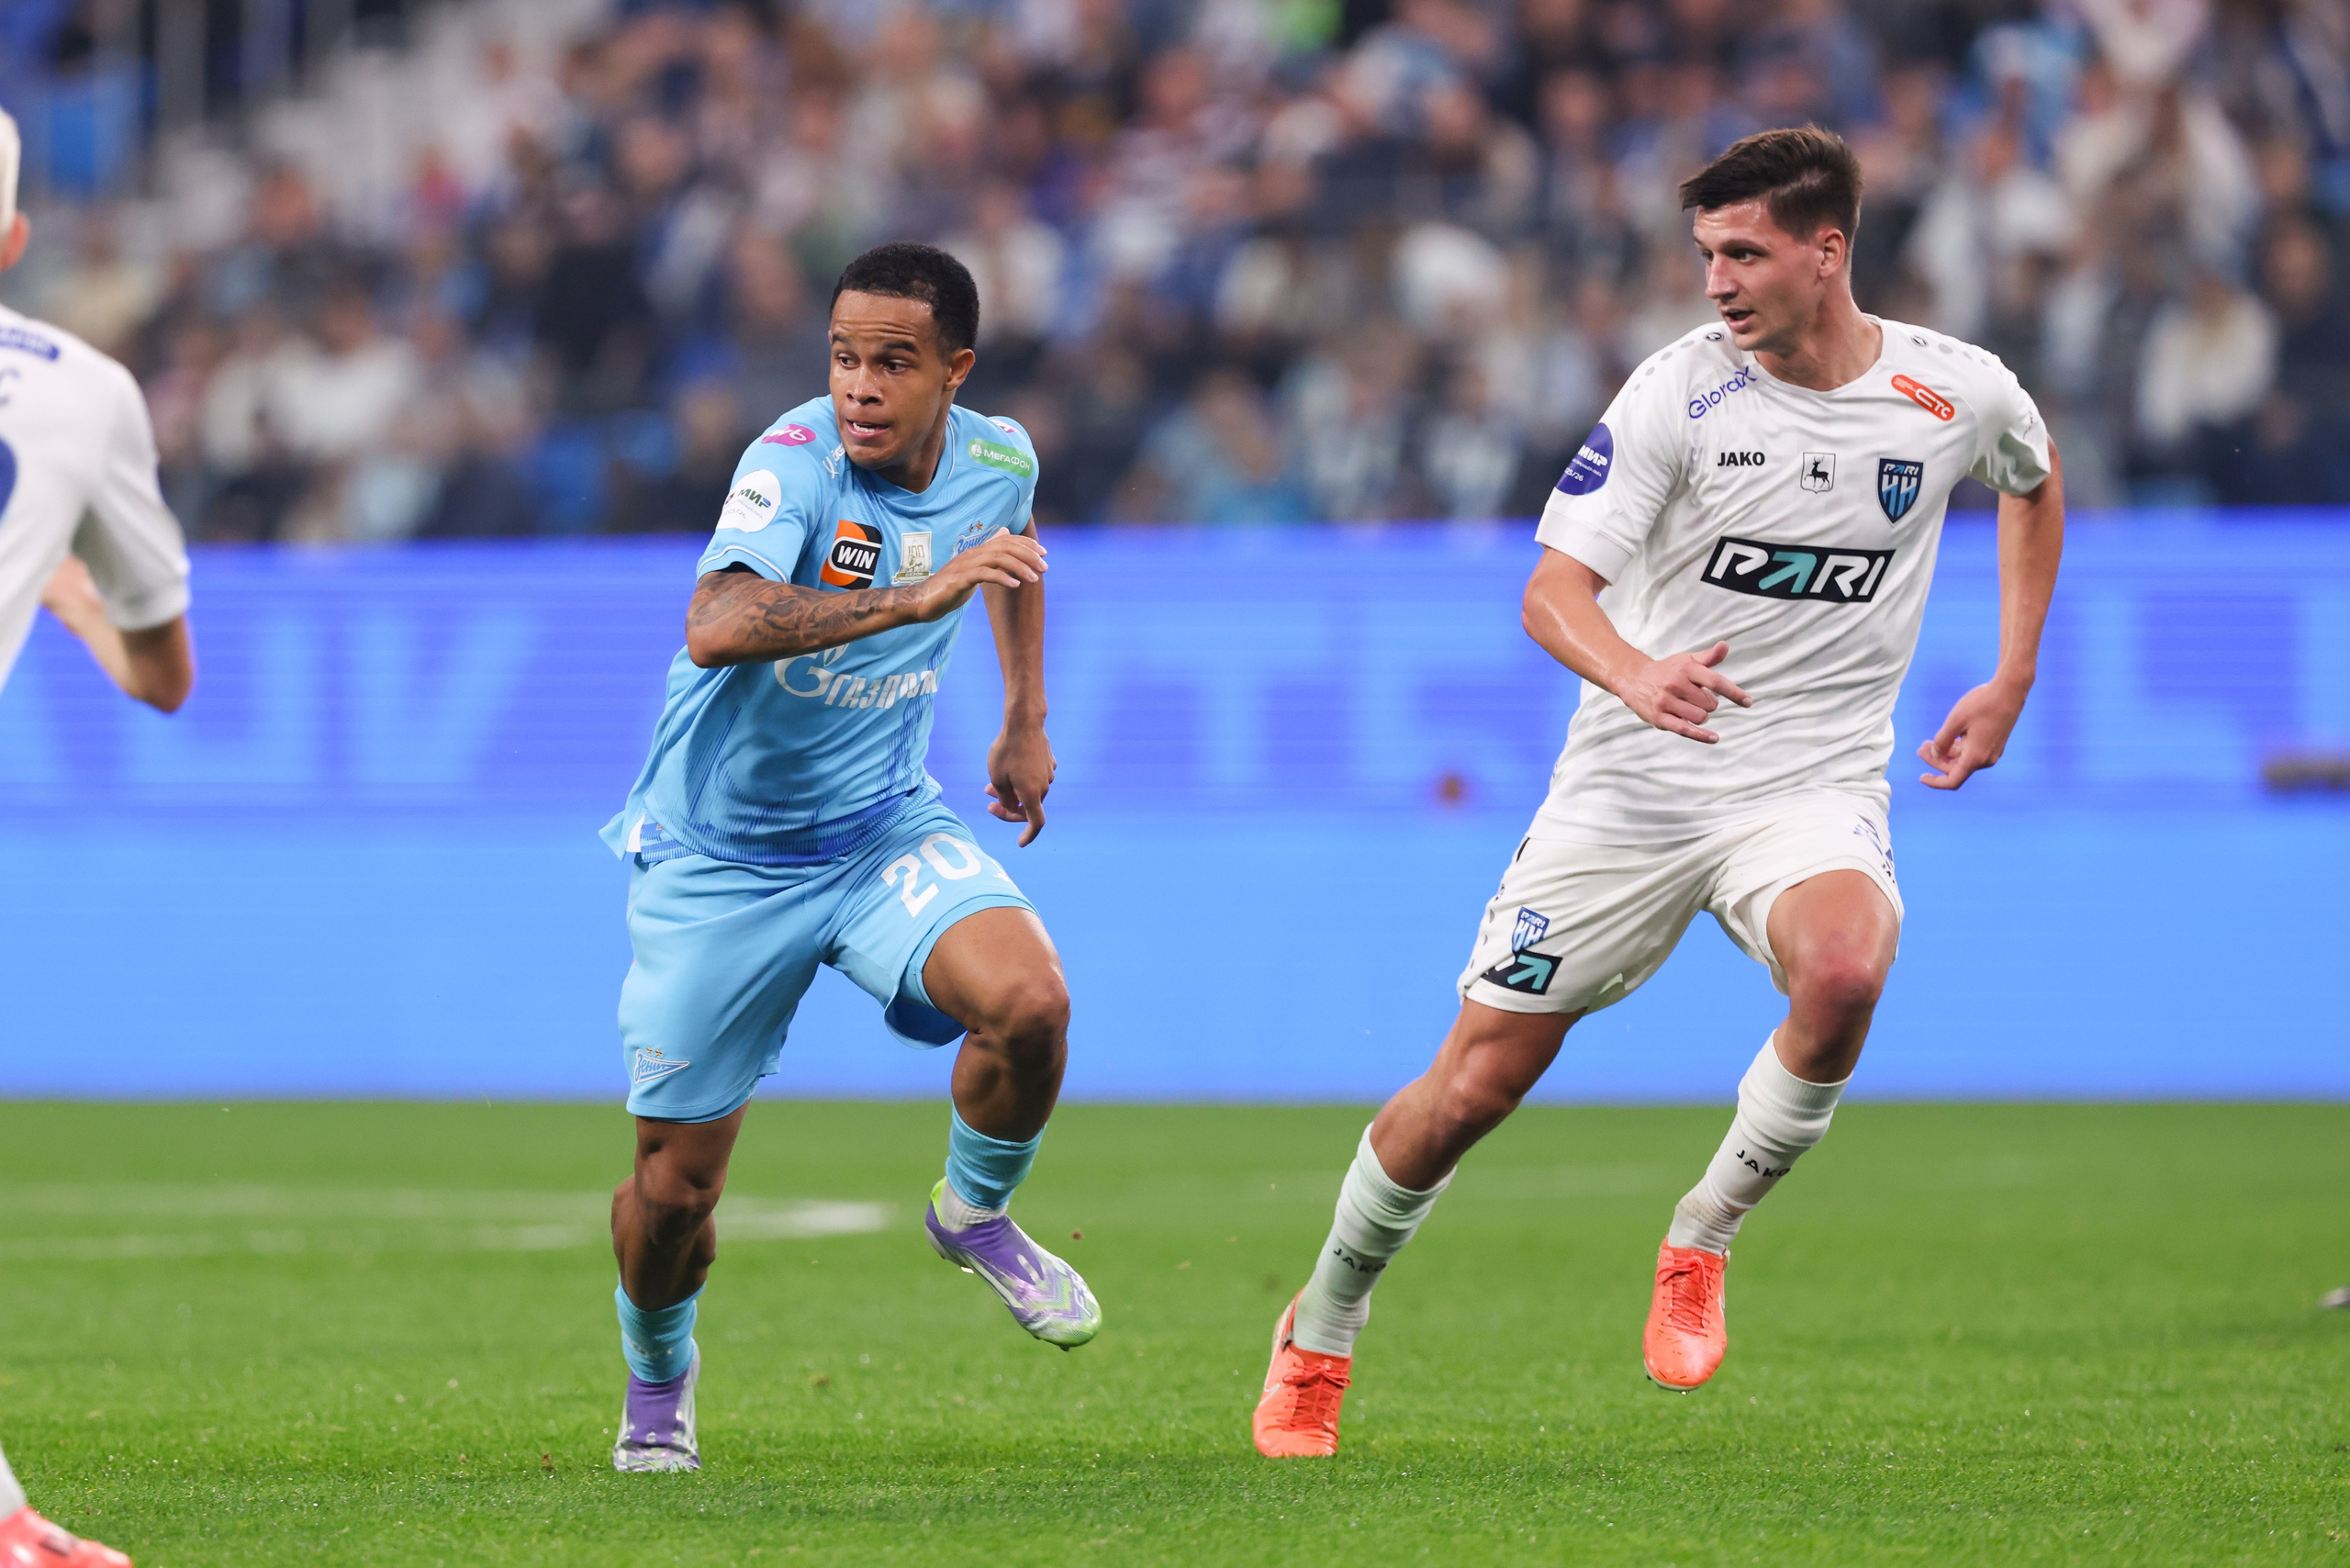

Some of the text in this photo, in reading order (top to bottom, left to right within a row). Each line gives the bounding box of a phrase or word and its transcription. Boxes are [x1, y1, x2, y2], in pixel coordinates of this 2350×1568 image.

[1718, 452, 1765, 466] JAKO
[1883, 463, 1919, 476] PARI
[837, 545, 876, 570] WIN
[1710, 542, 1886, 598] PARI
[881, 833, 981, 917] 20
